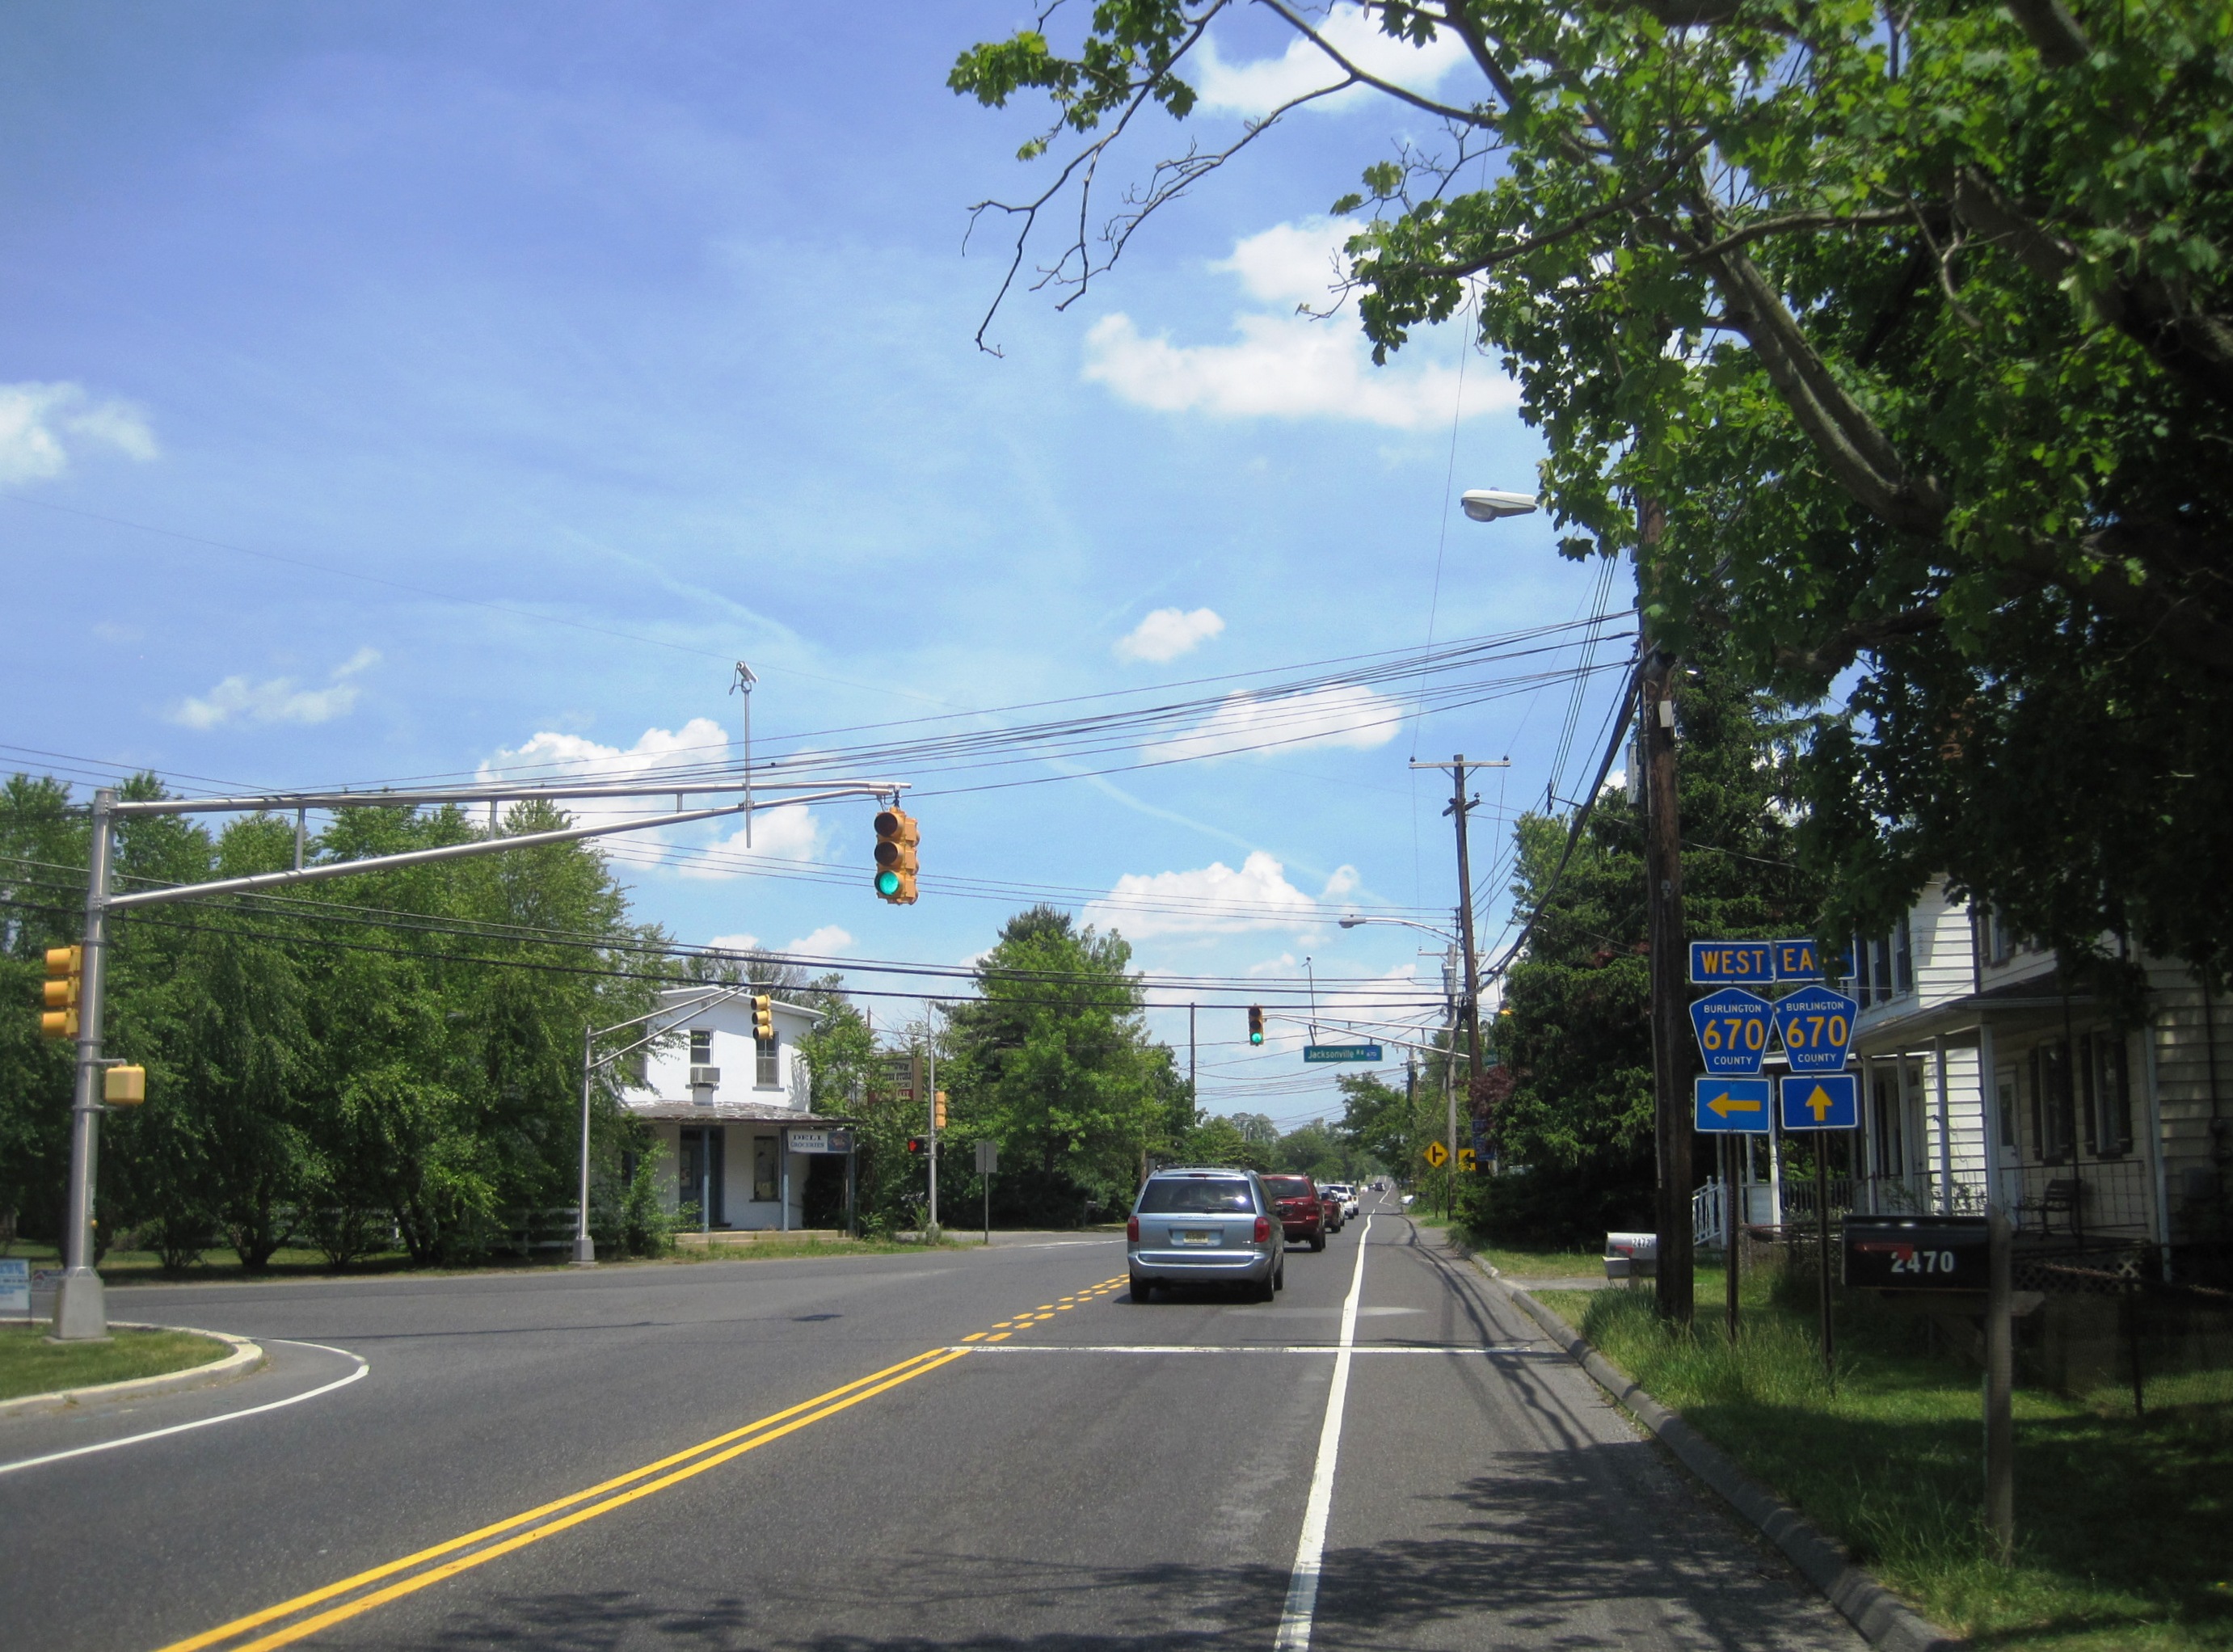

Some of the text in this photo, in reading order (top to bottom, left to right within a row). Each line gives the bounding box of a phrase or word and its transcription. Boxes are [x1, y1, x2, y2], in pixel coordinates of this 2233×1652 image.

[1700, 950, 1764, 974] WEST
[1704, 1005, 1762, 1014] BURLINGTON
[1786, 1001, 1844, 1012] BURLINGTON
[1703, 1018, 1764, 1051] 670
[1786, 1015, 1847, 1048] 670
[1308, 1049, 1355, 1059] Jacksonville
[1797, 1053, 1837, 1063] COUNTY
[1713, 1056, 1753, 1065] COUNTY
[1890, 1251, 1954, 1273] 2470
